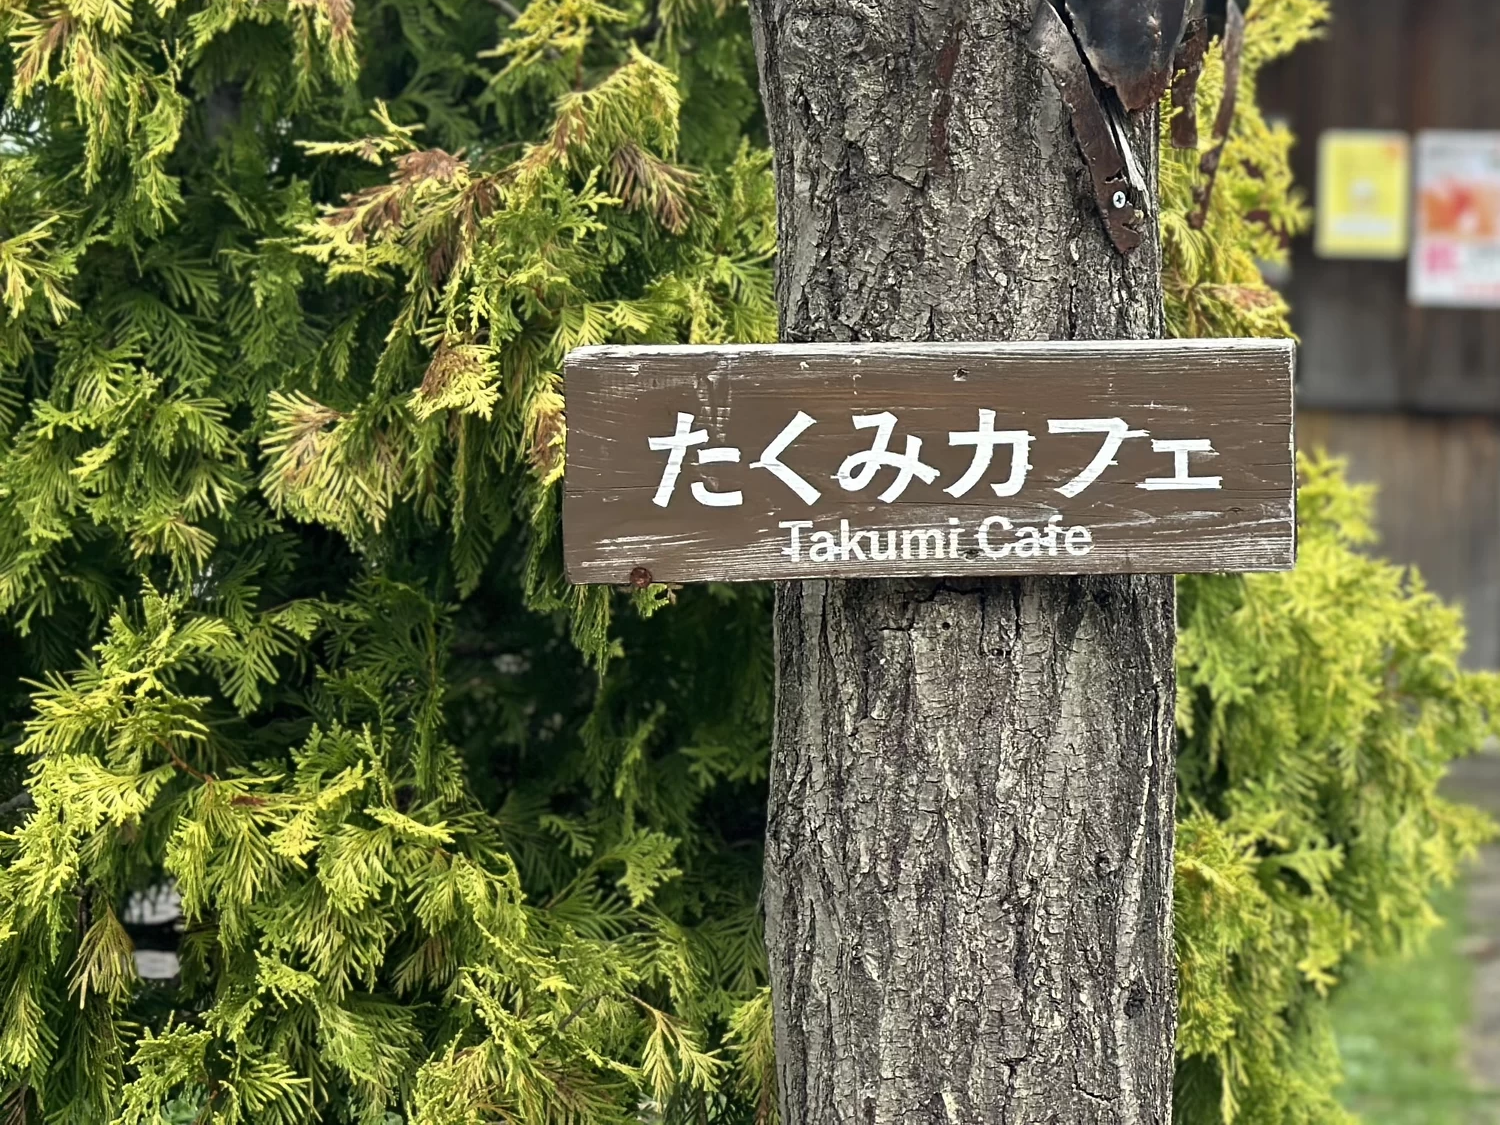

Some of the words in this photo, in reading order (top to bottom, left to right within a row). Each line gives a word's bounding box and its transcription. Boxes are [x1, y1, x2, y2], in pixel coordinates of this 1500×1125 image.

[648, 407, 1222, 508] たくみカフェ
[778, 518, 966, 563] Takumi
[973, 514, 1095, 560] Cafe
